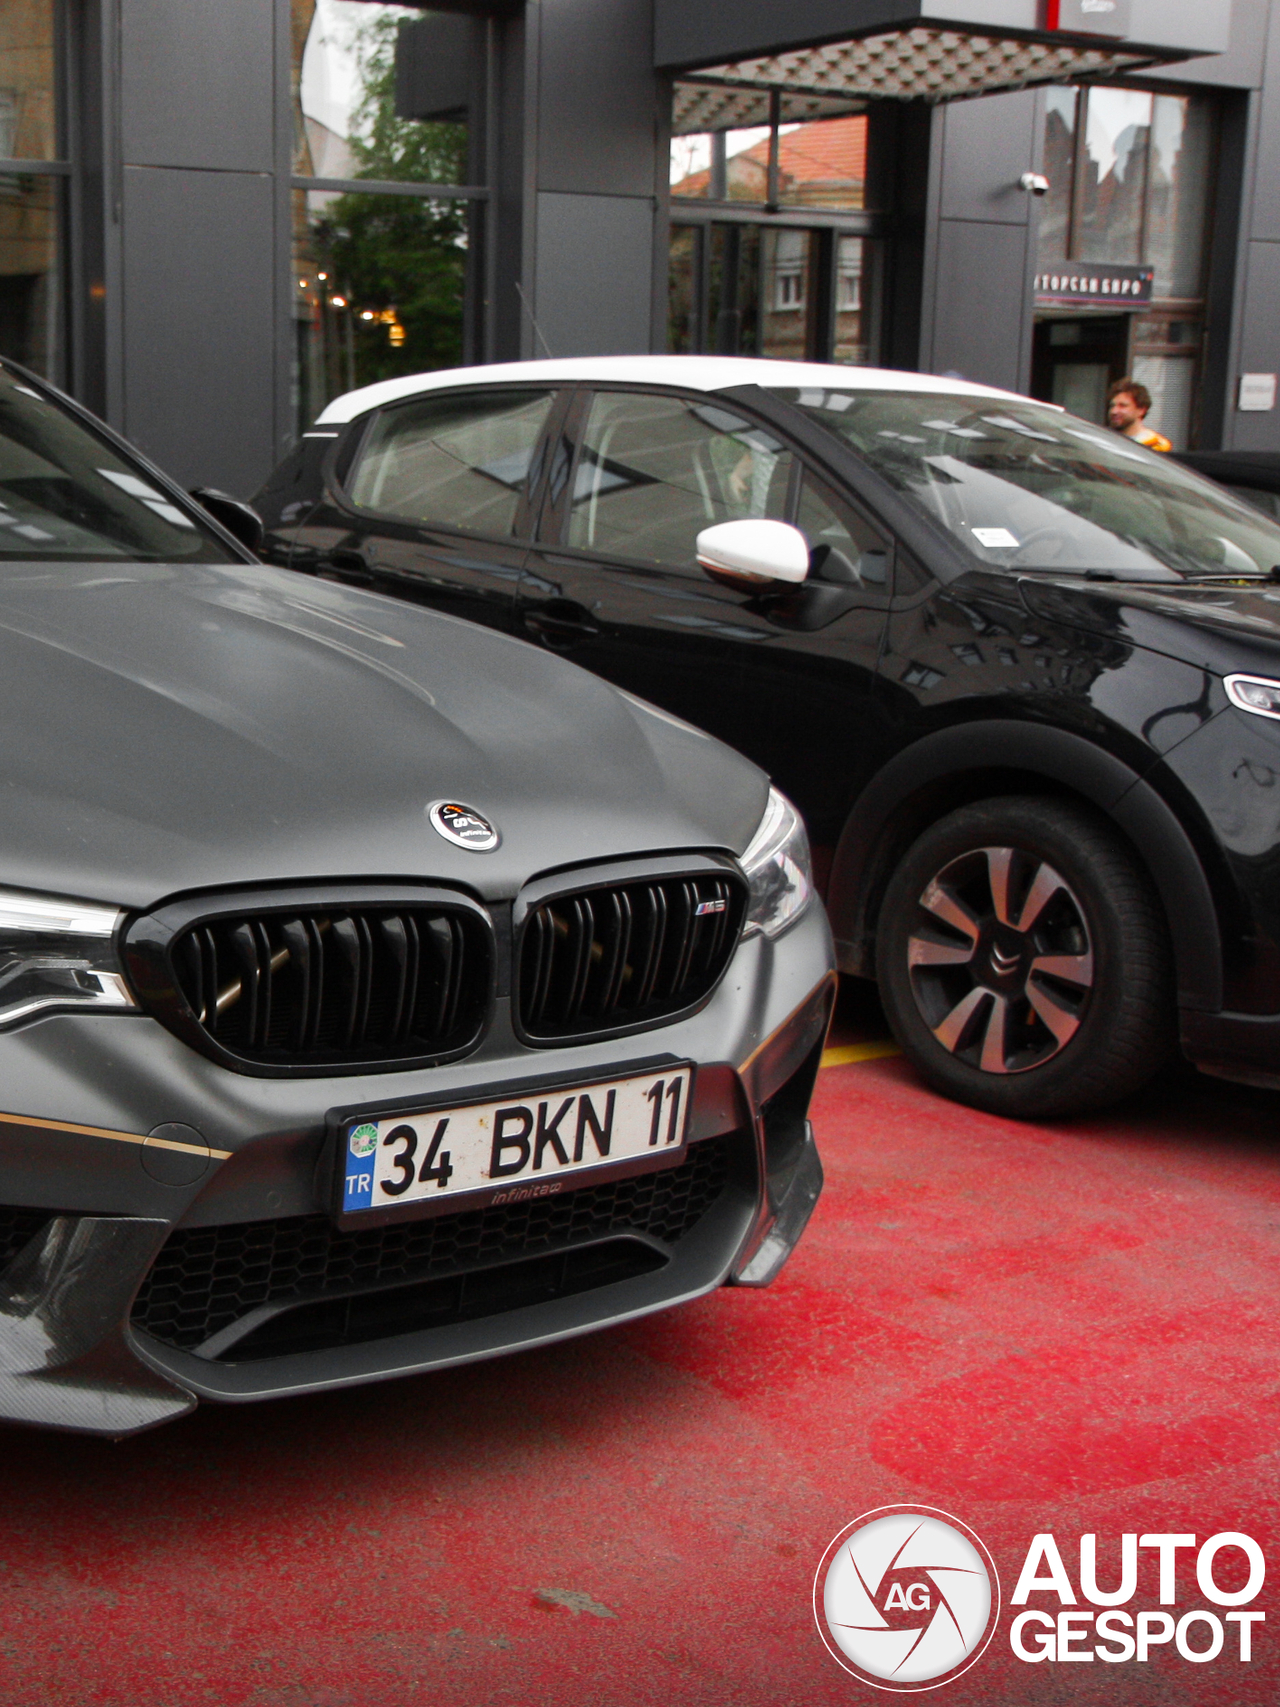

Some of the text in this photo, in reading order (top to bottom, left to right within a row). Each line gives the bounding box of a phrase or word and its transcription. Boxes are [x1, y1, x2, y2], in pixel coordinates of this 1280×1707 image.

[380, 1076, 683, 1196] 34 BKN 11
[345, 1173, 371, 1195] TR
